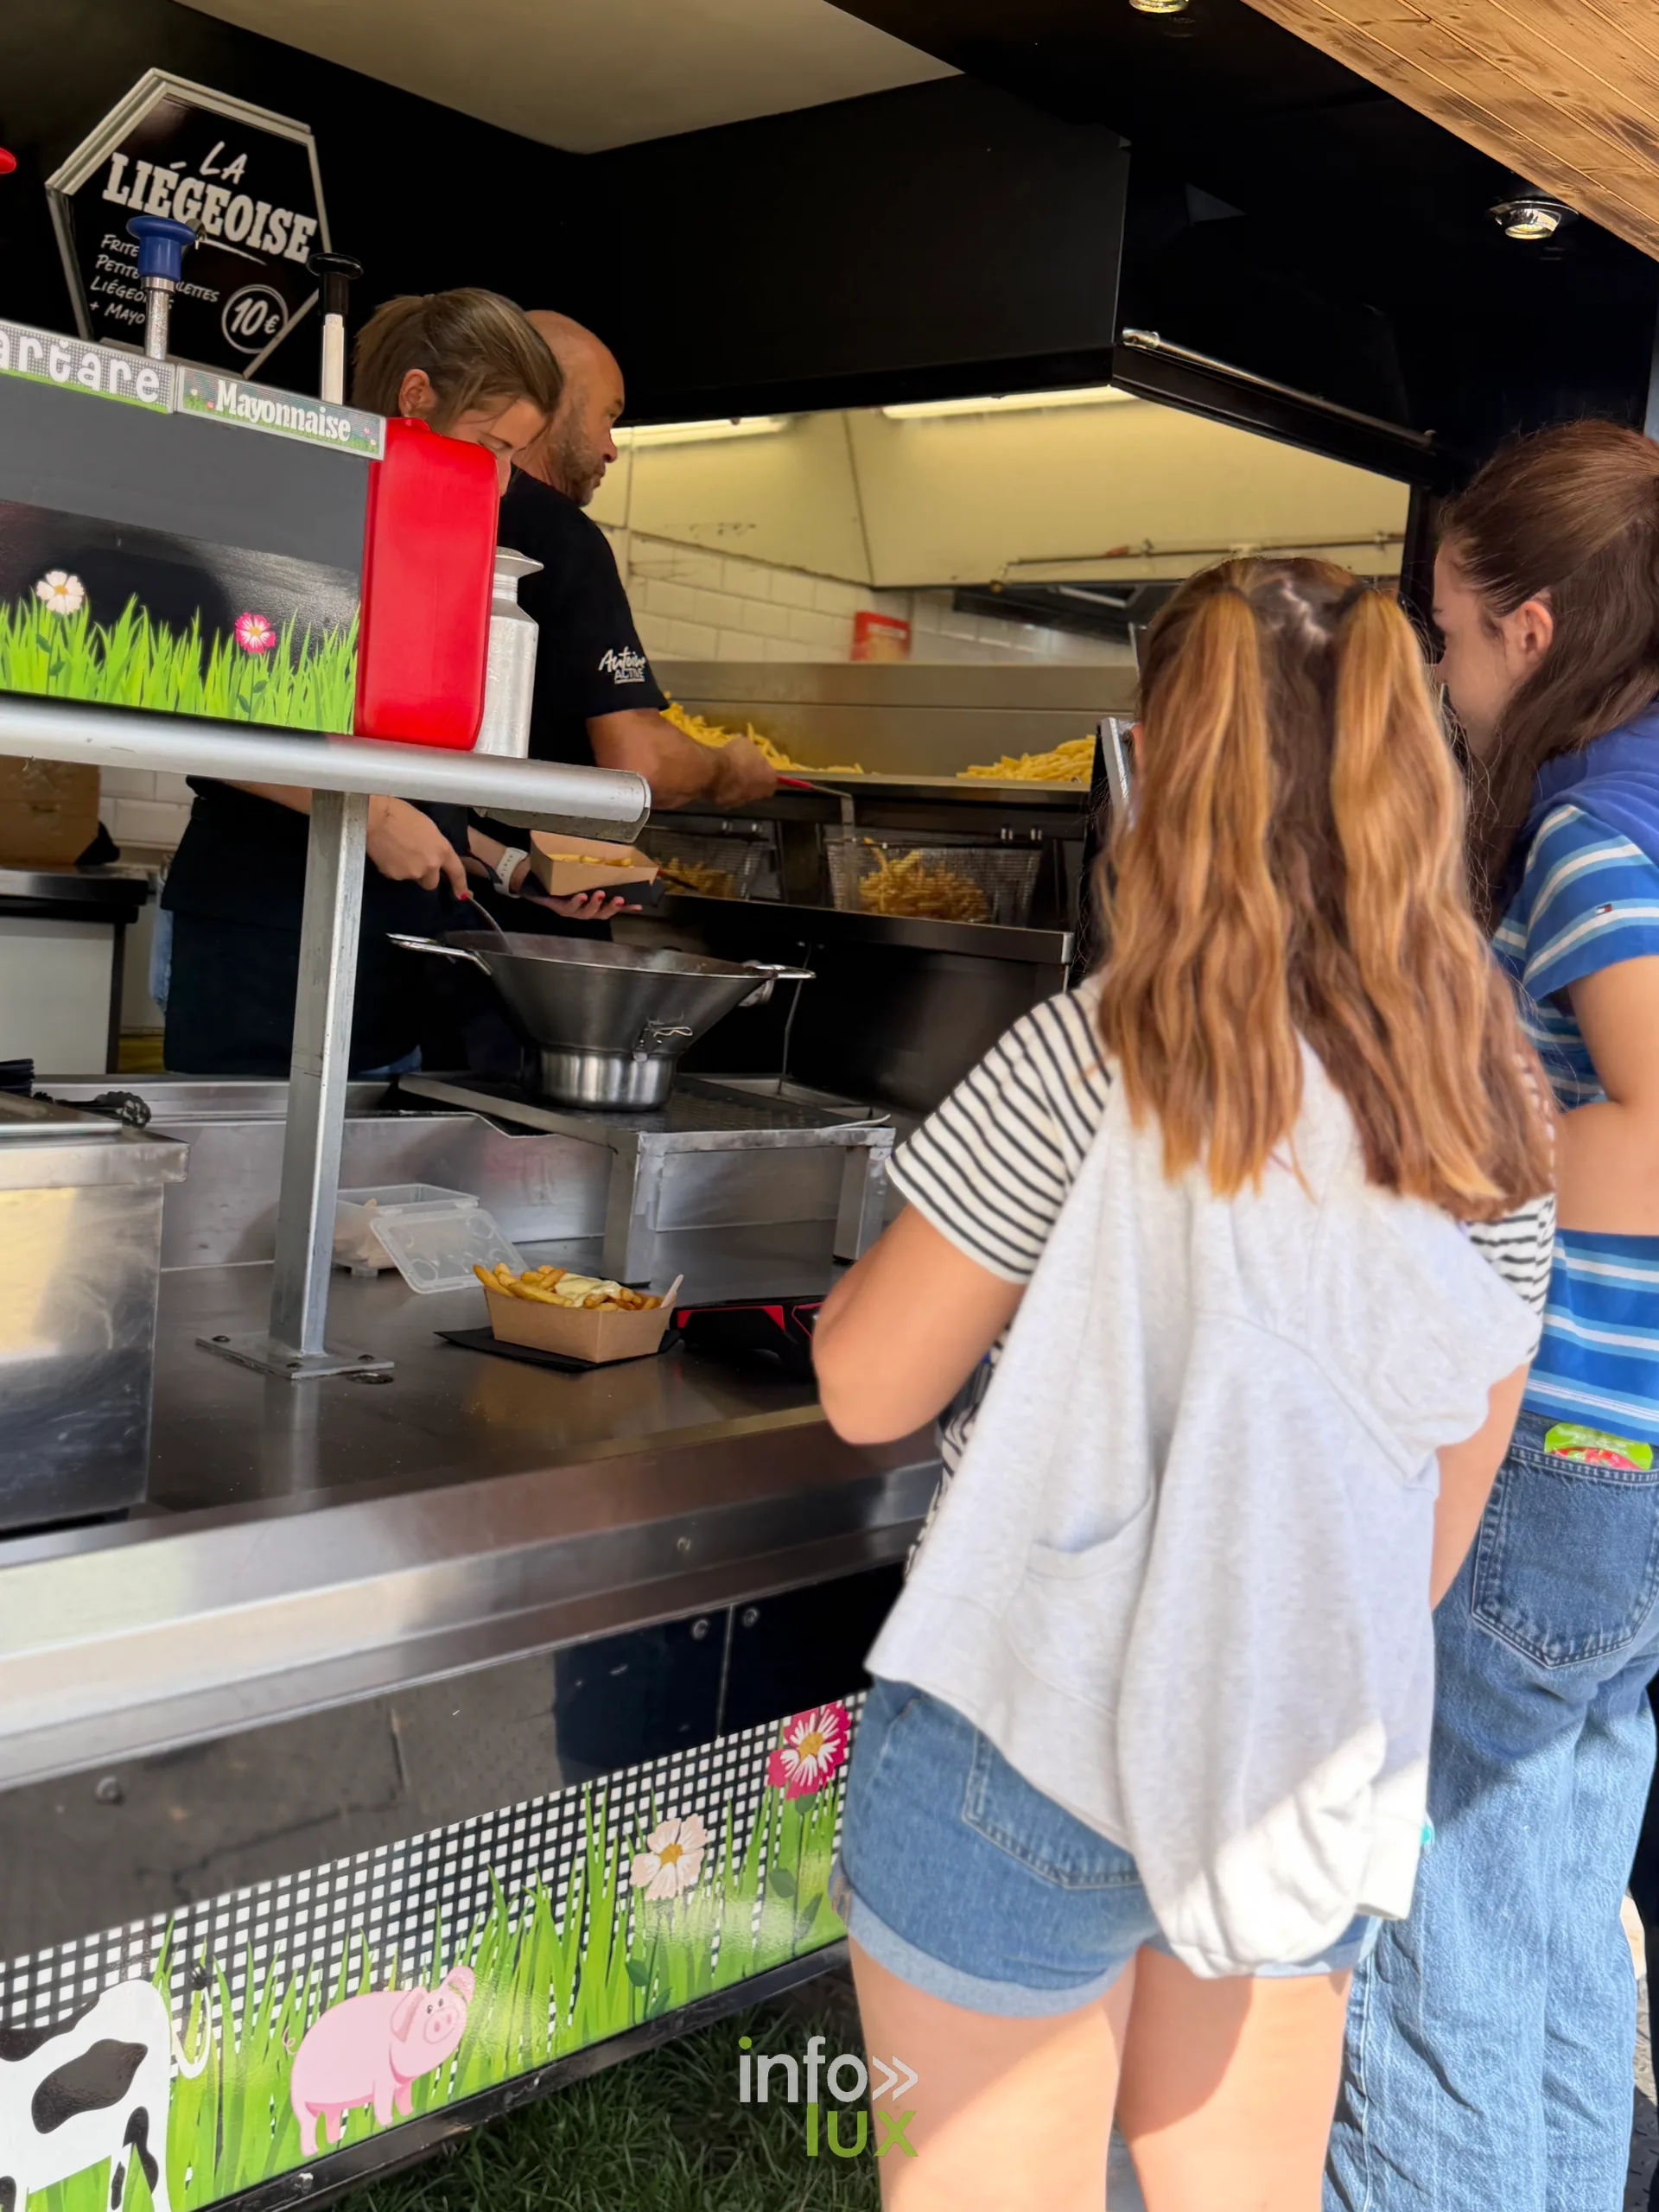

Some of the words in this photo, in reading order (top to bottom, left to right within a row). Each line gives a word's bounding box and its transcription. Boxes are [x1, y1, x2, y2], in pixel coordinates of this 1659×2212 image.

[199, 141, 248, 184] LA
[102, 152, 318, 264] LIÉGEOISE
[100, 234, 140, 257] FRITE
[104, 302, 146, 326] MAYO
[216, 378, 352, 442] Mayonnaise
